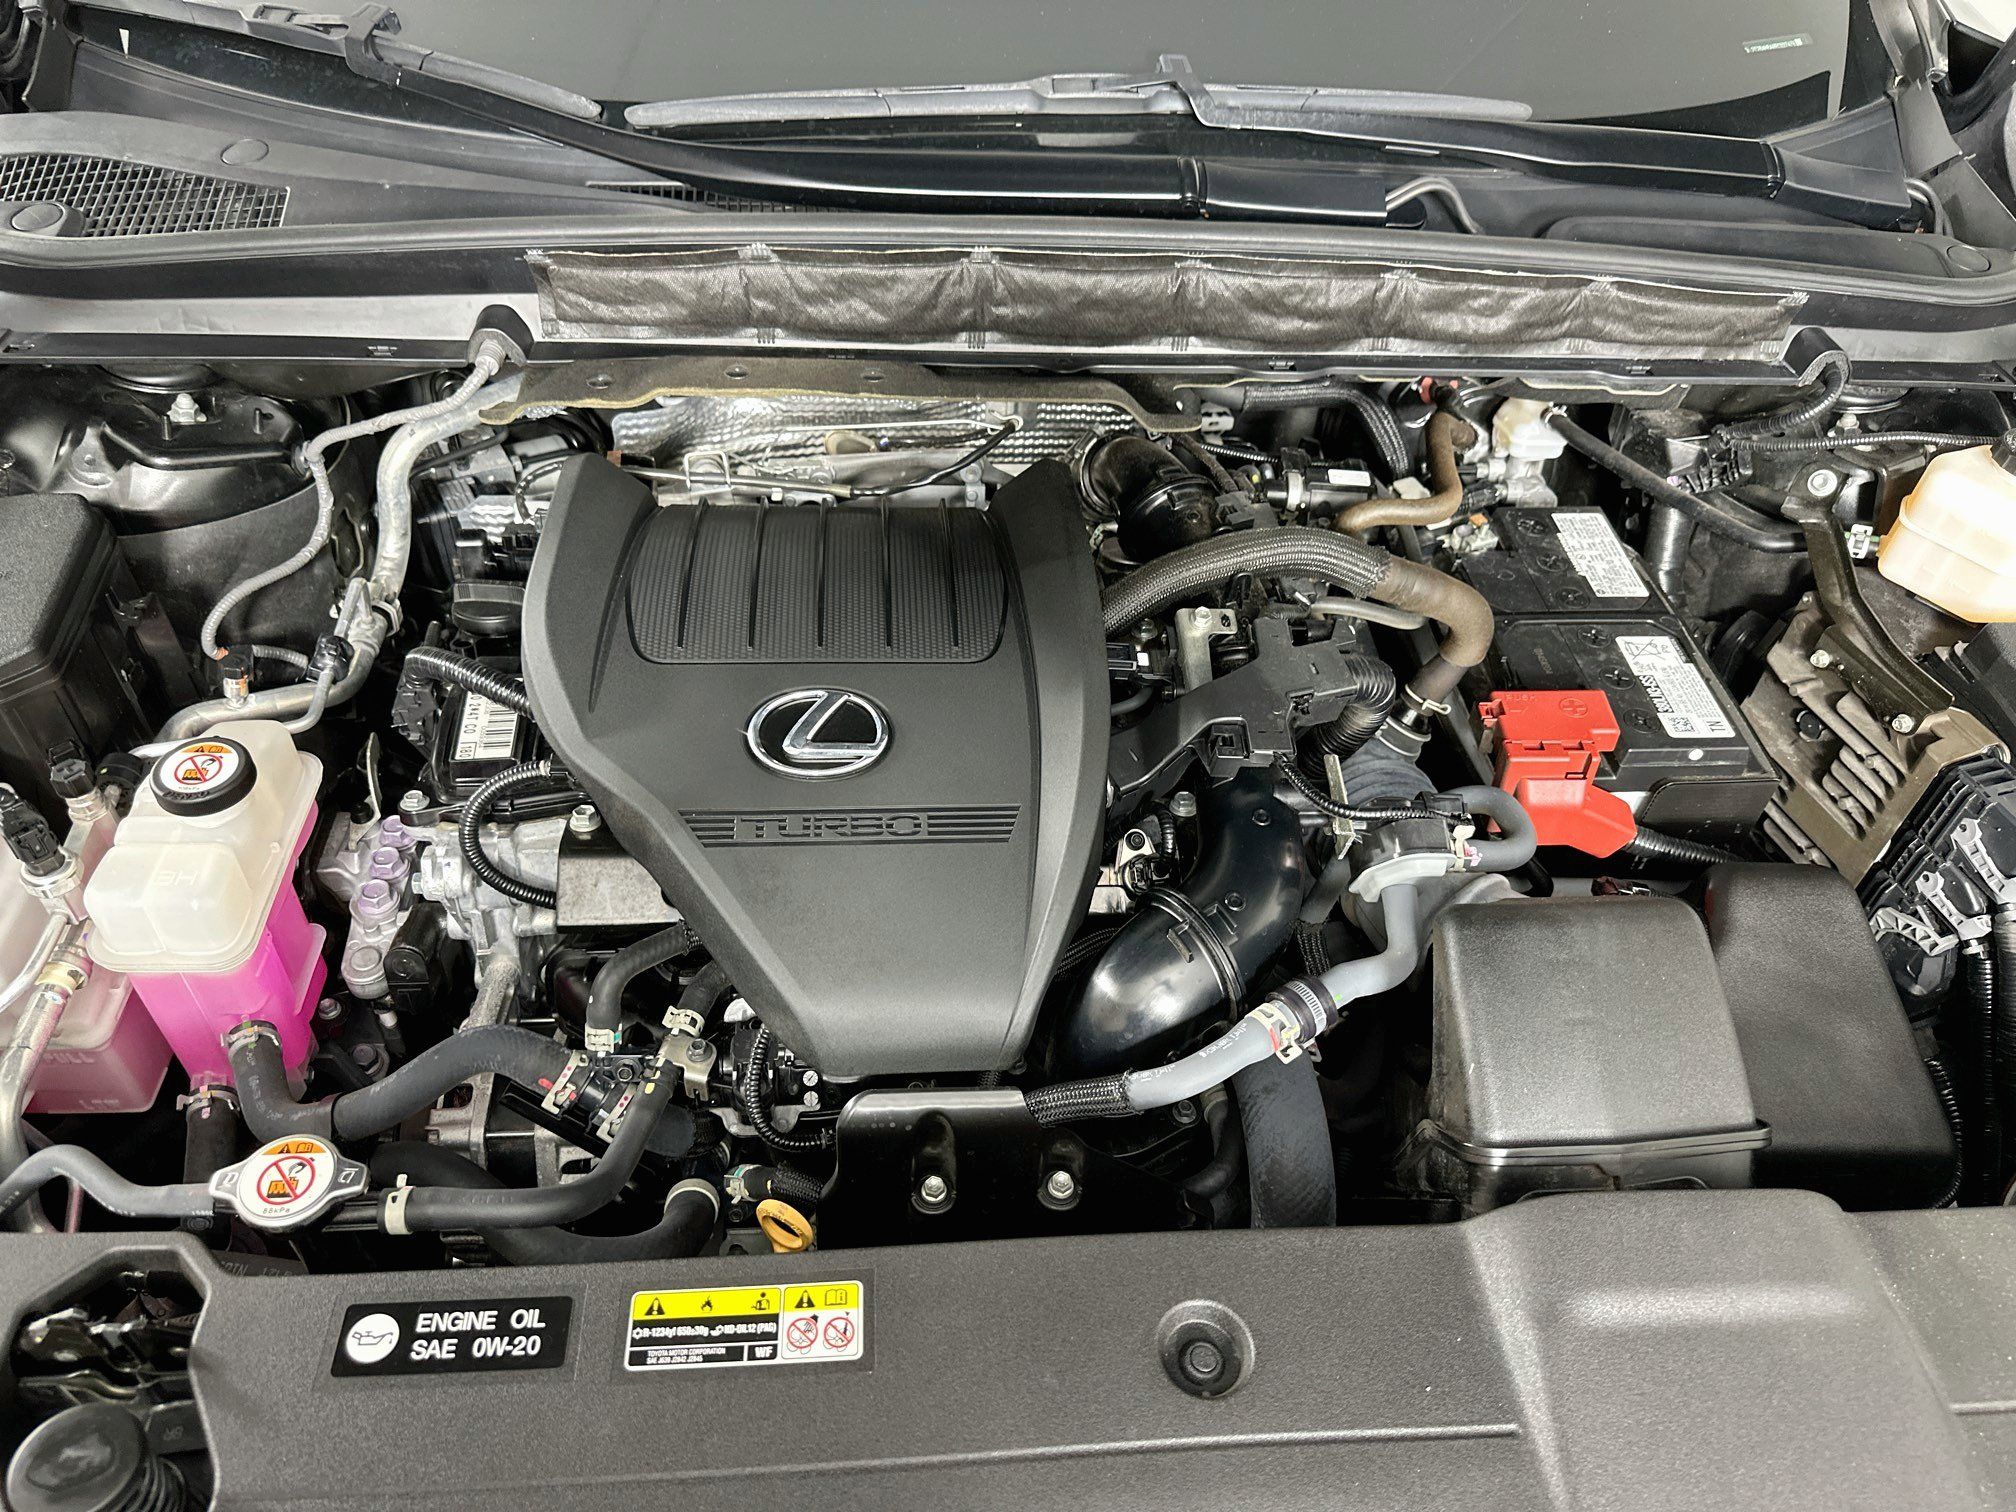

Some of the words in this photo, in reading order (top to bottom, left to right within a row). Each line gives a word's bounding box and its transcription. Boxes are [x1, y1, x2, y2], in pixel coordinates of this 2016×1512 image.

[740, 813, 923, 838] TURBO
[415, 1310, 498, 1333] ENGINE
[510, 1308, 546, 1329] OIL
[410, 1338, 458, 1360] SAE
[472, 1335, 541, 1358] 0W-20
[689, 1347, 726, 1355] CORPORATION
[755, 1346, 773, 1358] WF
